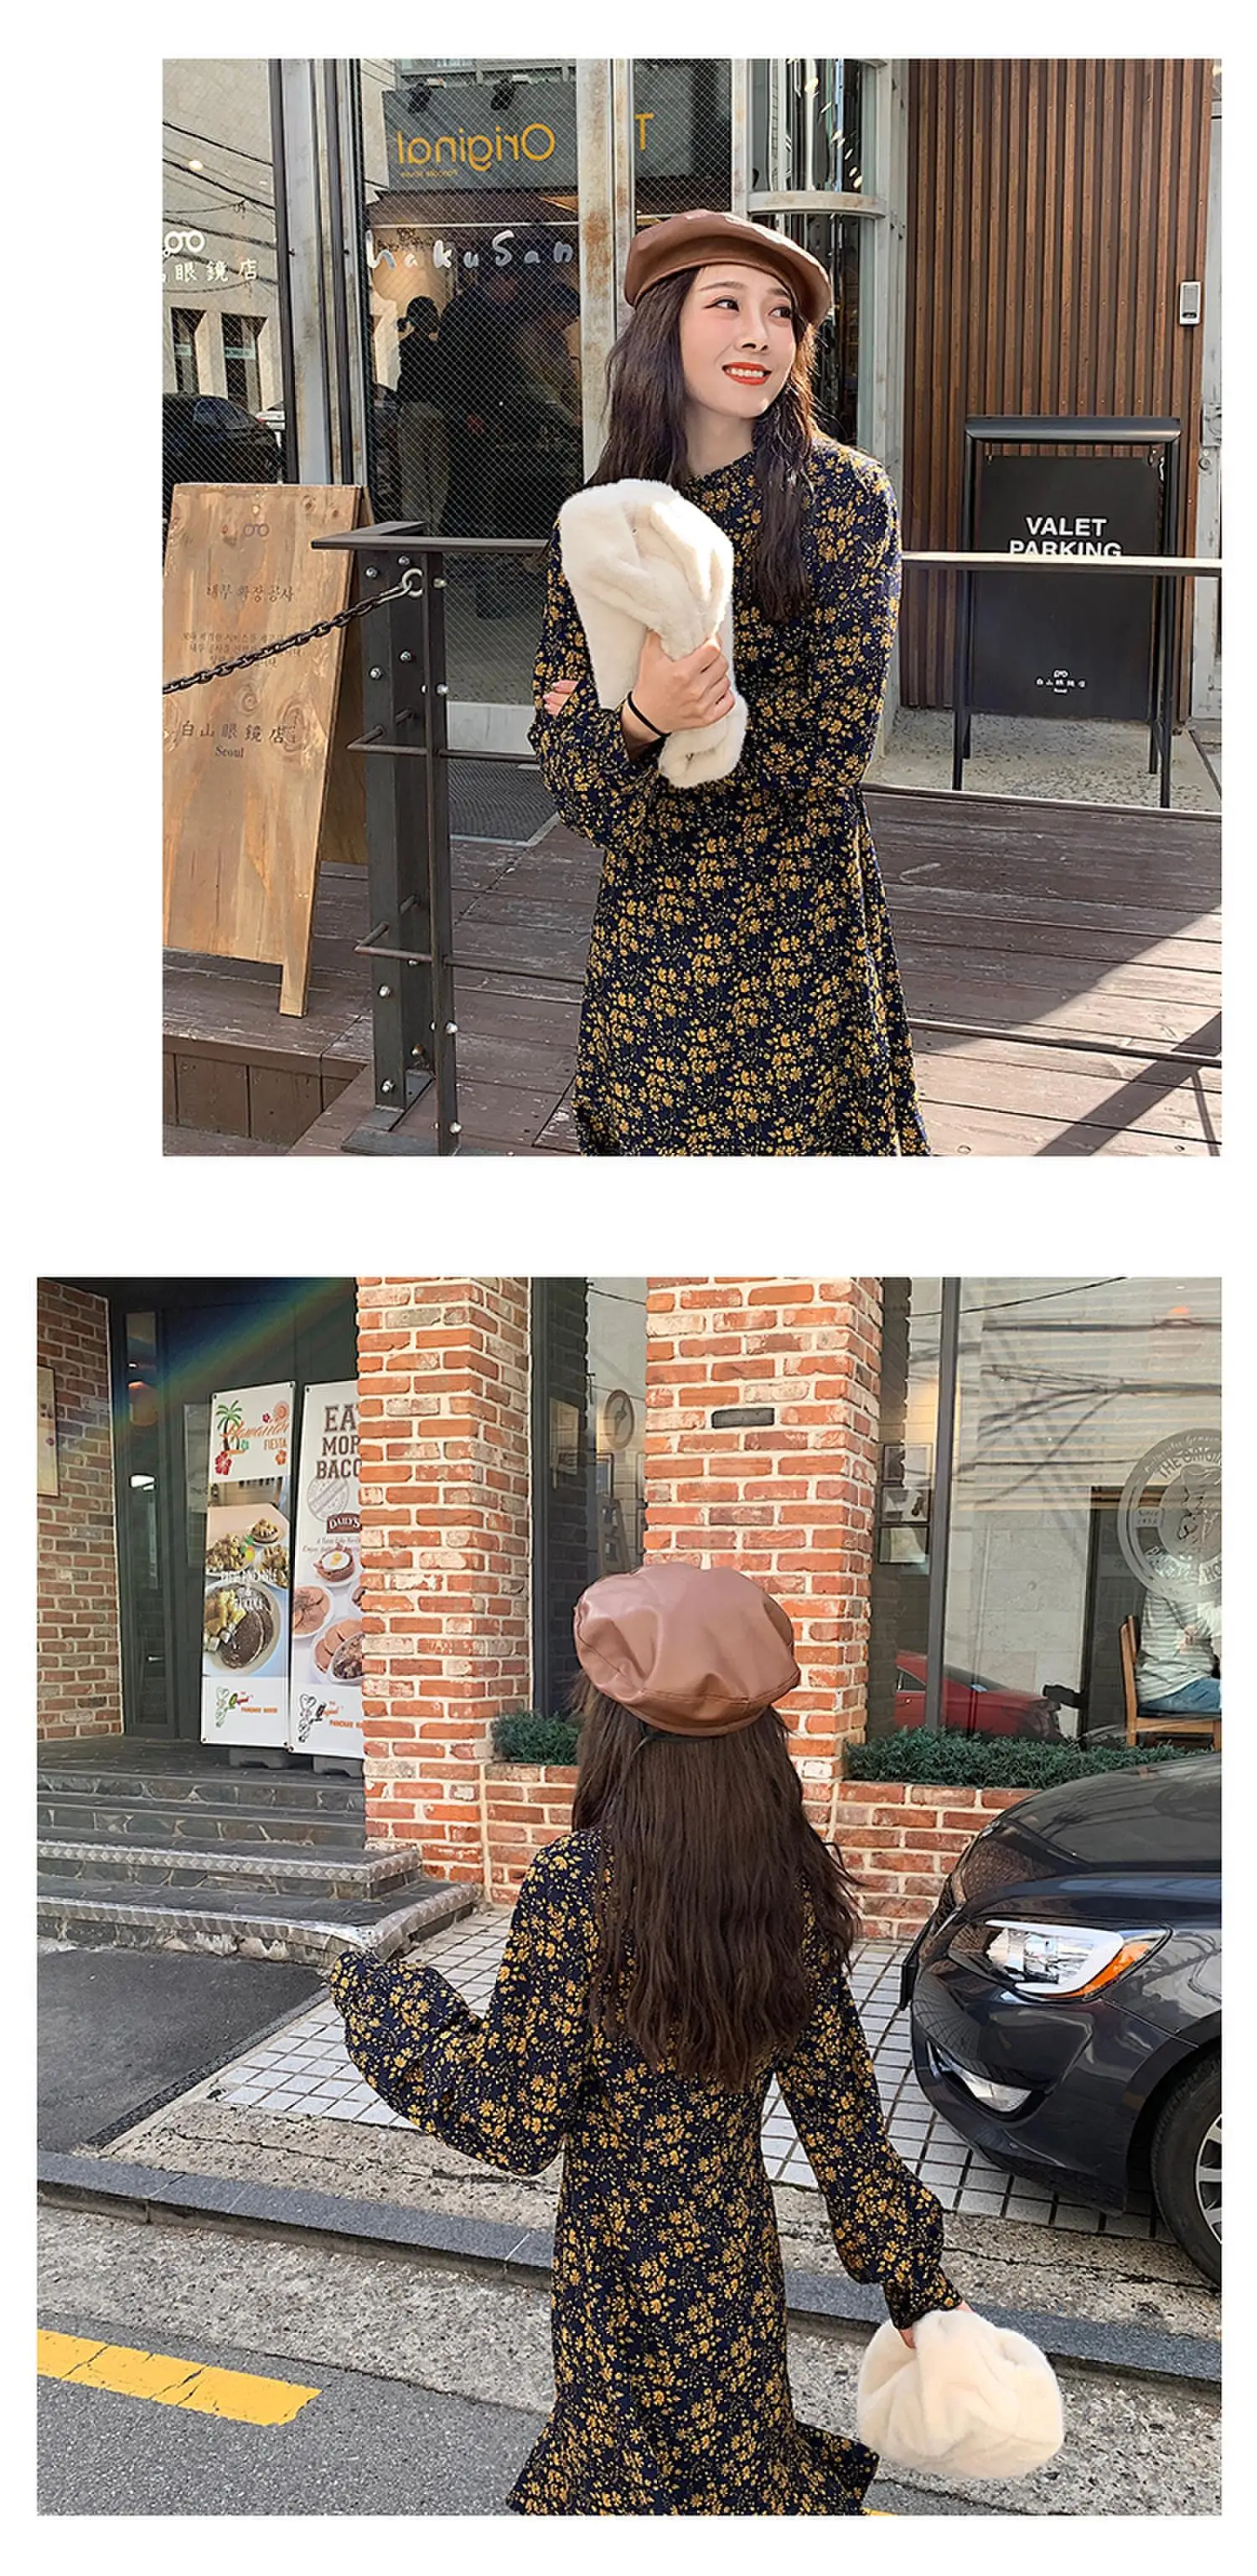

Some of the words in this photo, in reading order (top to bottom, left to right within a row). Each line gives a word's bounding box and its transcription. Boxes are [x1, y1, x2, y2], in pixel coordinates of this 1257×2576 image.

[1026, 517, 1107, 537] VALET
[1010, 540, 1122, 556] PARKING
[182, 720, 284, 744] 白山眼鏡店
[215, 744, 245, 758] Seoul
[324, 1404, 360, 1432] EA
[263, 1438, 288, 1451] FIESTA
[322, 1435, 361, 1456] MOR
[1158, 1458, 1182, 1479] THE
[1203, 1560, 1221, 1582] HO
